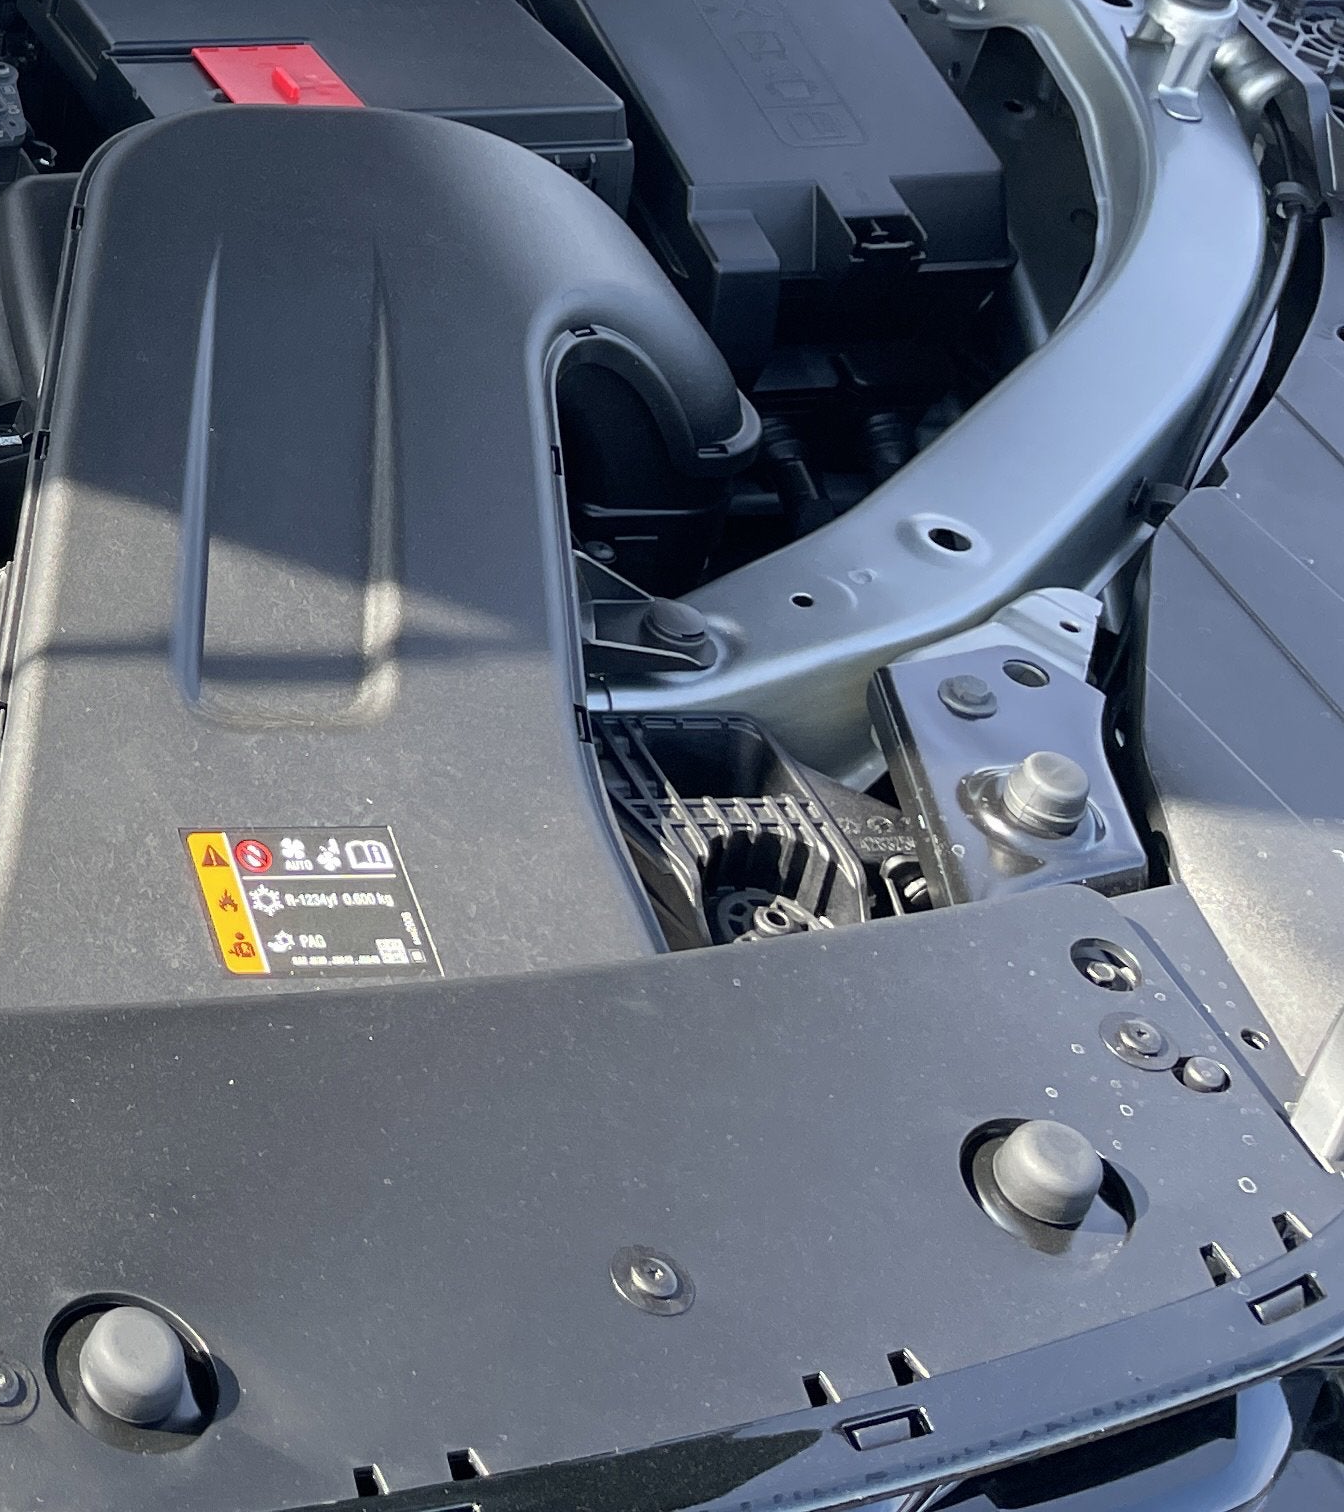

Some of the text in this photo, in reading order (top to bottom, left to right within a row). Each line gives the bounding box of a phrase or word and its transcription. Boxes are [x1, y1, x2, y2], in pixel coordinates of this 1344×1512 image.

[285, 859, 313, 871] AUTO
[284, 892, 338, 908] R-1234yf
[377, 892, 394, 907] kg
